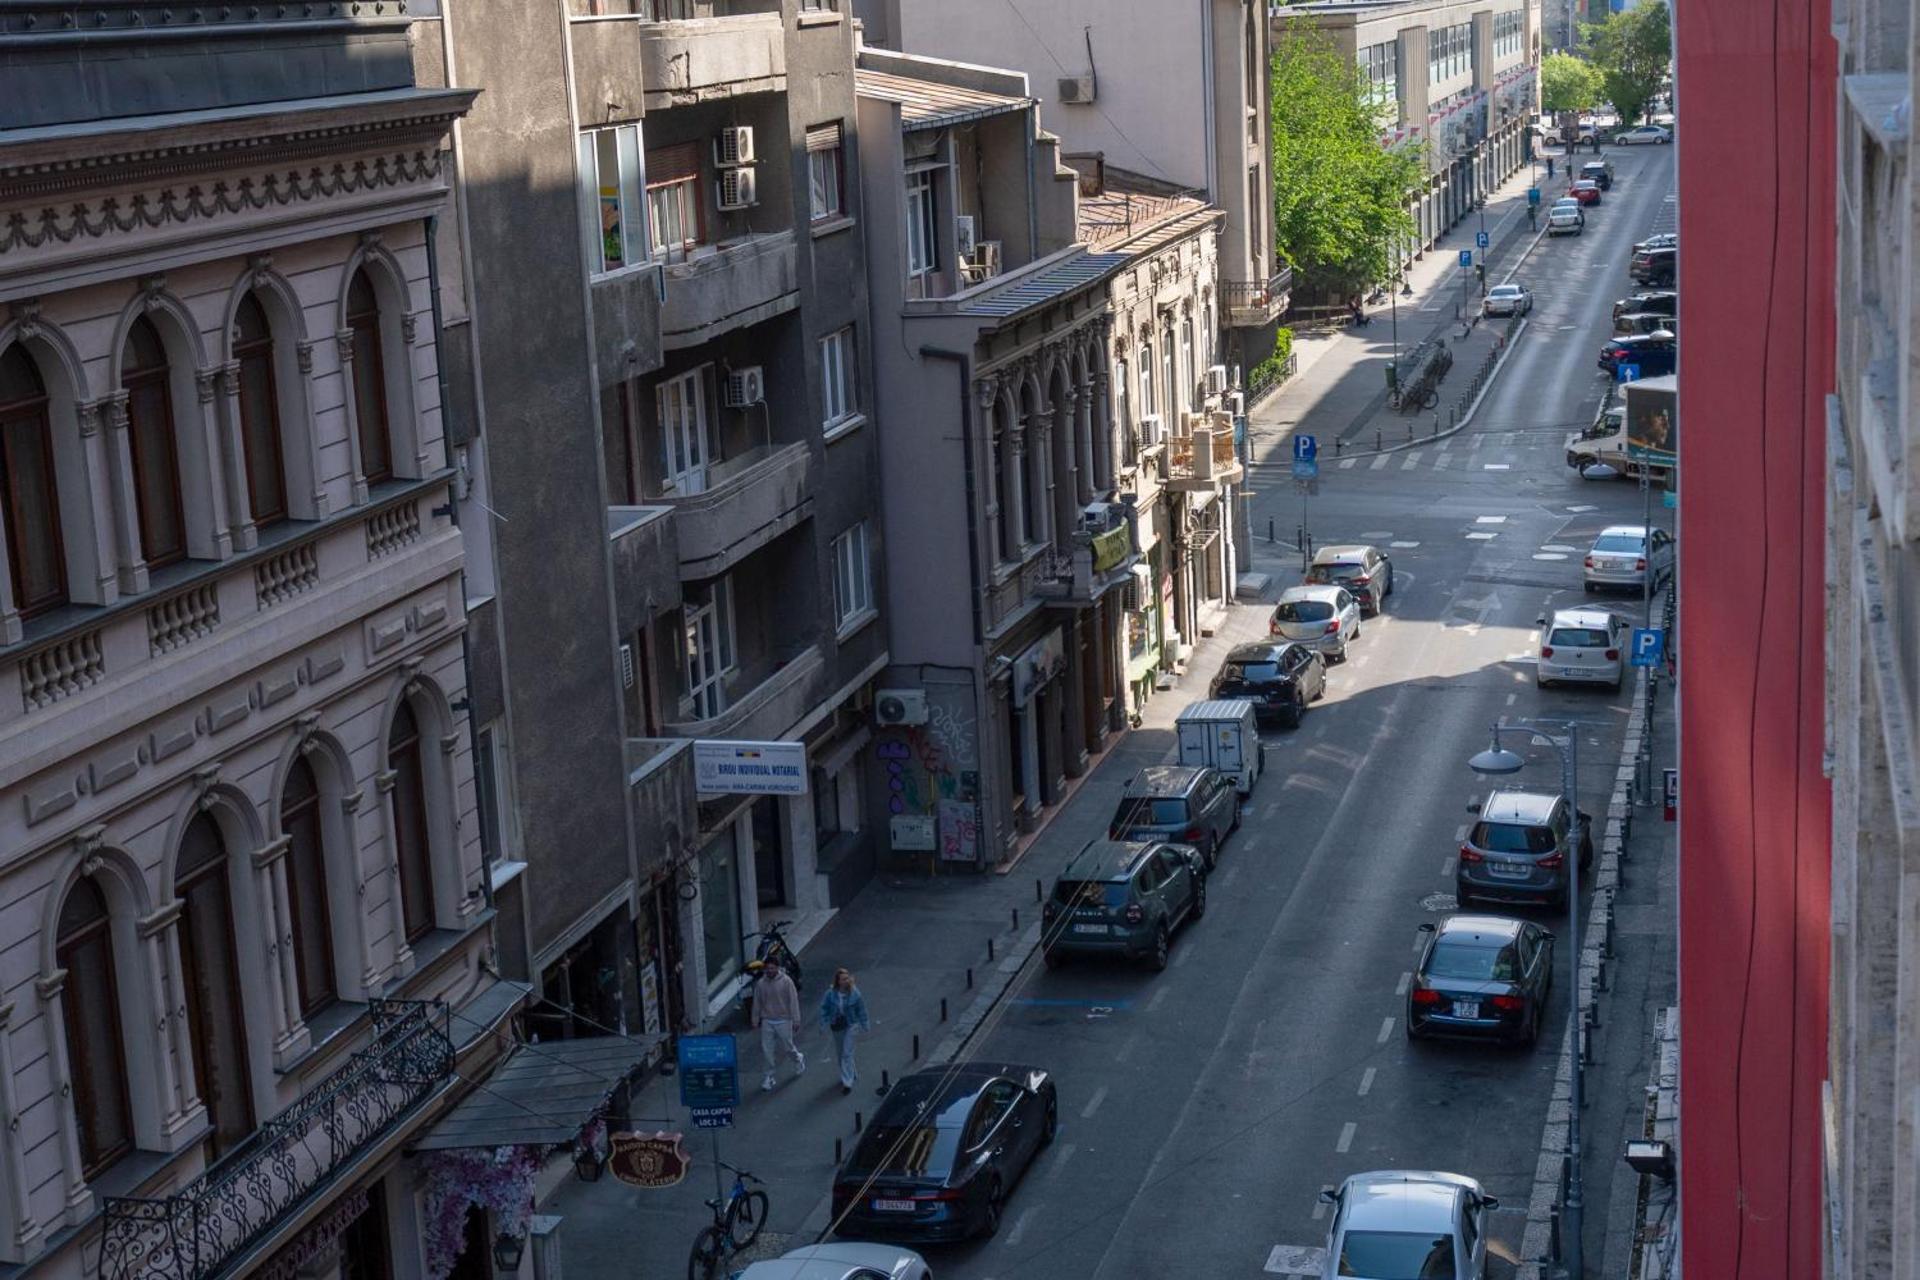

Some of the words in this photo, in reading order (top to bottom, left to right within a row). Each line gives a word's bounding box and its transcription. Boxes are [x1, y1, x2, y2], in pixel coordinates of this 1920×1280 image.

[1299, 436, 1310, 458] P
[1639, 632, 1656, 655] P
[737, 764, 771, 776] INDIVIDUAL
[772, 765, 800, 777] NOTARIAL
[693, 1108, 710, 1116] CASA
